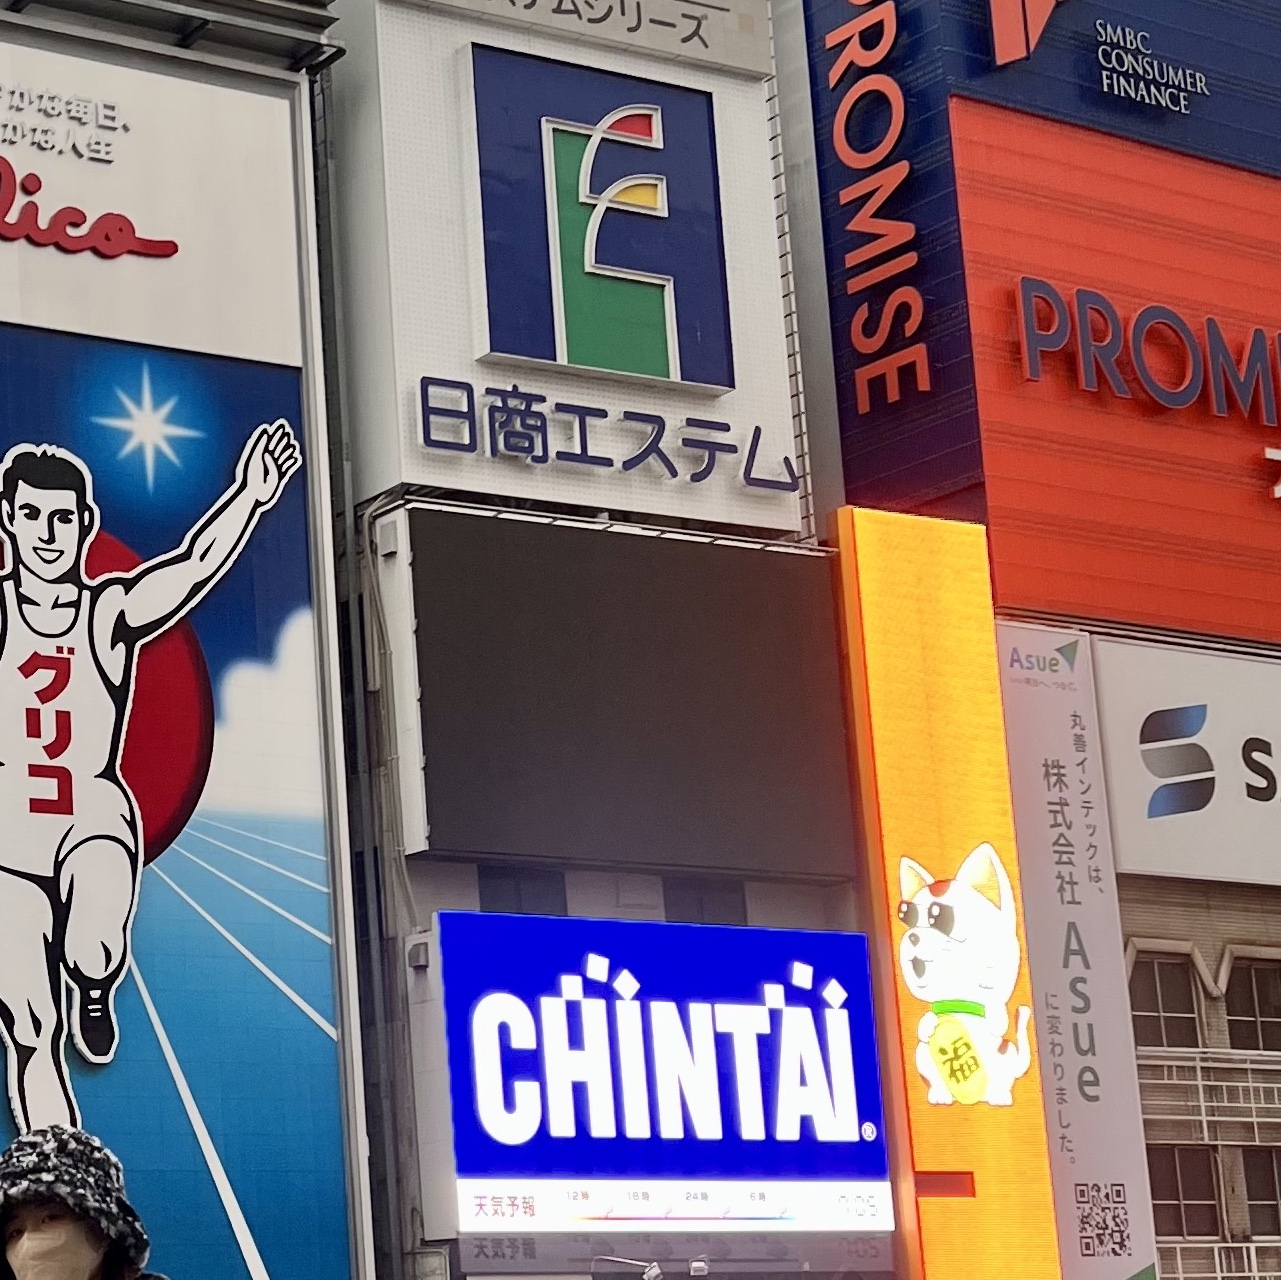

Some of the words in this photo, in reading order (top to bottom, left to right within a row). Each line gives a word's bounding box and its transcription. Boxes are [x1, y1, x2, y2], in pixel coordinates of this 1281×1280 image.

[506, 0, 709, 49] ムシリーズ
[1095, 19, 1153, 54] SMBC
[1097, 45, 1210, 96] CONSUMER
[1101, 70, 1191, 115] FINANCE
[824, 0, 932, 415] ROMISE
[1019, 276, 1281, 427] PROM
[420, 375, 800, 492] 日商エステム
[1009, 646, 1060, 674] Asue
[16, 645, 76, 816] グリコ
[1241, 737, 1281, 802] S
[1041, 757, 1082, 906] 株式会社
[1070, 709, 1104, 894] 丸善インテックは、
[471, 952, 861, 1146] CHINTAI
[938, 1036, 980, 1085] 福
[1061, 921, 1101, 1103] Asue
[1044, 991, 1077, 1166] に変わりました。
[473, 1195, 536, 1218] 天気予報
